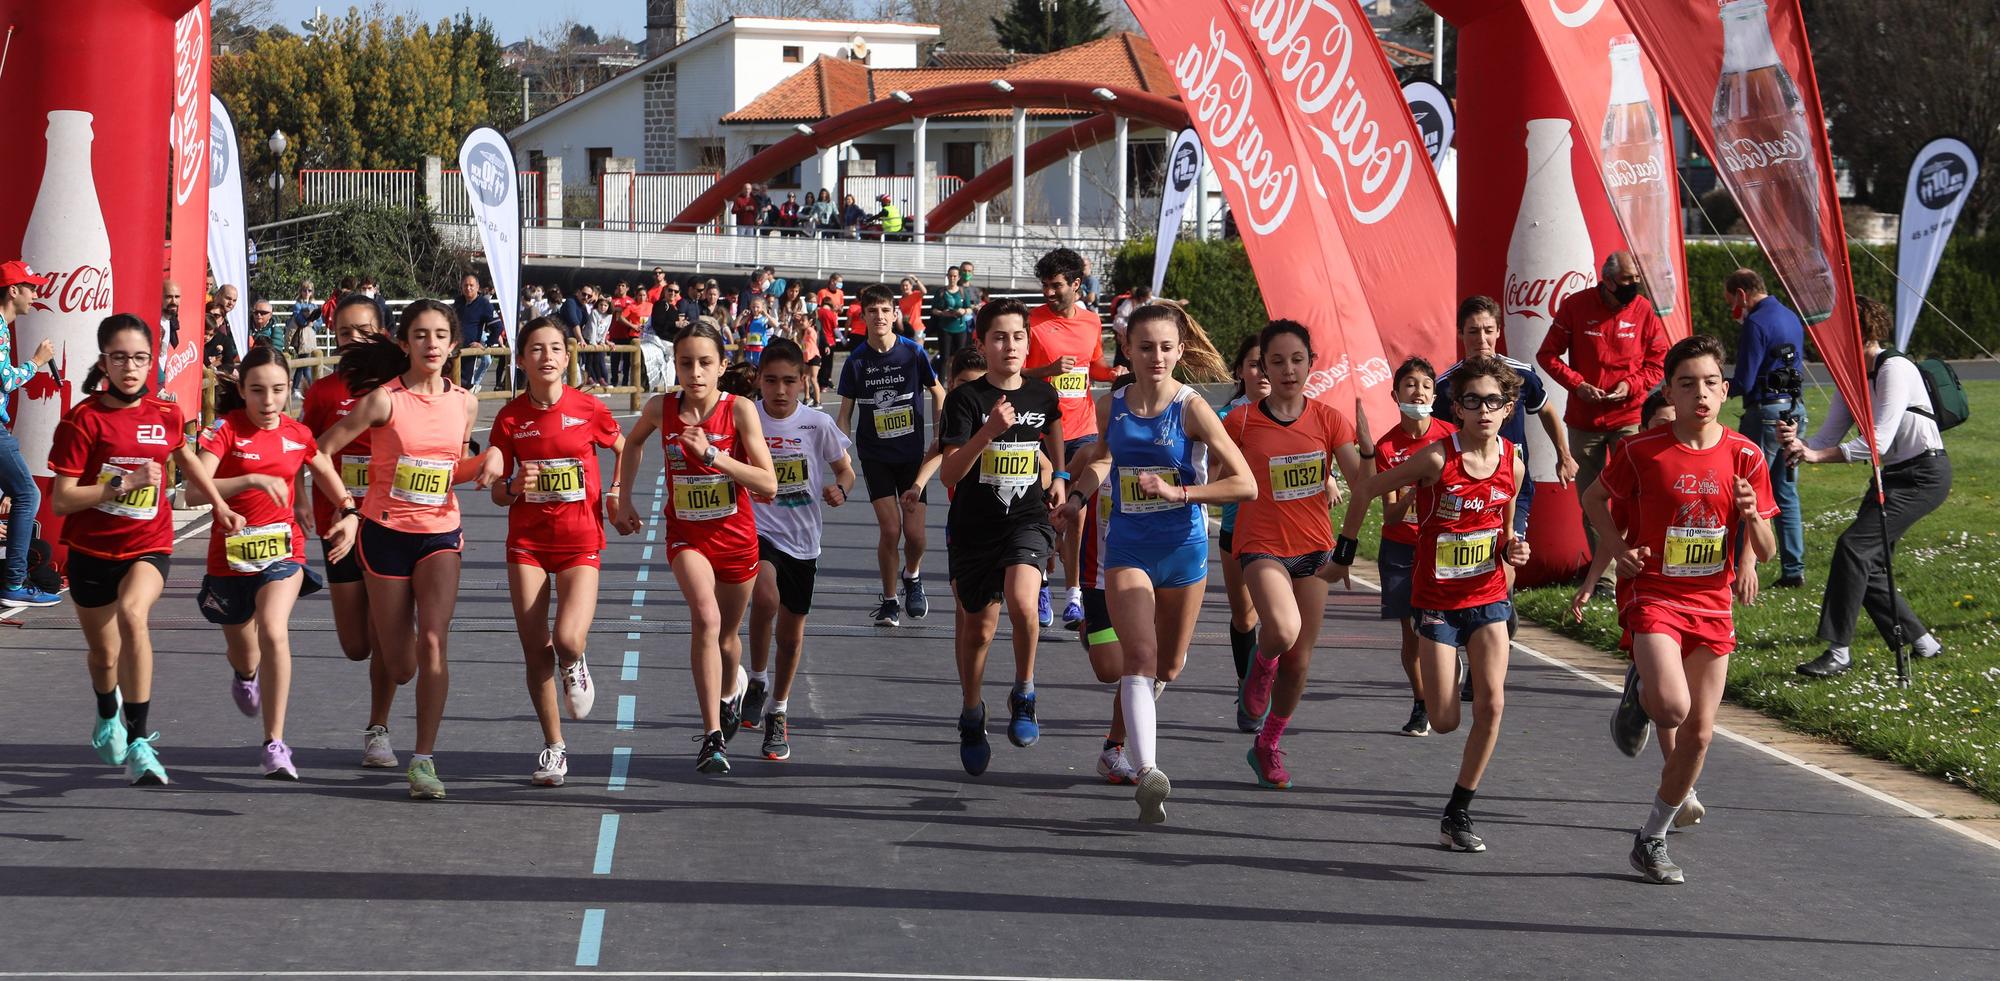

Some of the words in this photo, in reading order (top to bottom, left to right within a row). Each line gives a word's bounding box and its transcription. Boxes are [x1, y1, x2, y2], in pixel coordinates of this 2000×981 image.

[1059, 377, 1081, 390] 1322
[883, 414, 908, 431] 1009
[137, 424, 166, 440] ED
[1000, 443, 1007, 451] 10
[994, 456, 1029, 475] 1002
[1284, 456, 1293, 464] 10
[409, 472, 441, 493] 1015
[537, 472, 572, 492] 1020
[687, 476, 695, 485] 10
[776, 466, 797, 483] 24
[1284, 466, 1317, 488] 1032
[1673, 474, 1697, 494] 42
[688, 489, 721, 509] 1014
[1463, 497, 1484, 512] edp
[1686, 528, 1695, 538] 10
[240, 538, 278, 560] 1026
[1453, 544, 1484, 566] 1010
[1685, 544, 1715, 564] 1011
